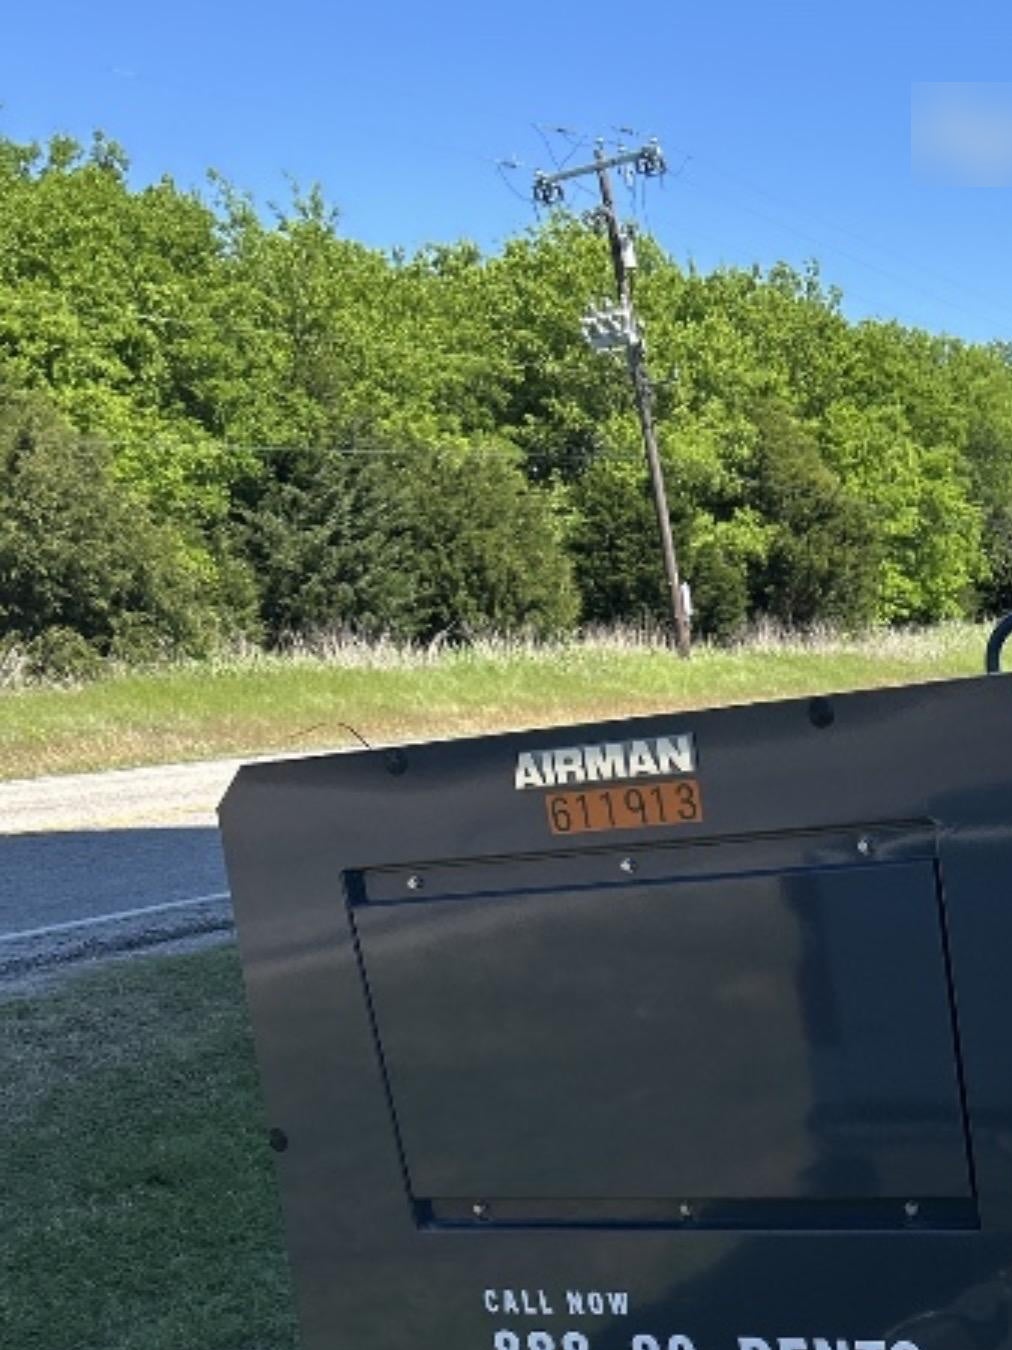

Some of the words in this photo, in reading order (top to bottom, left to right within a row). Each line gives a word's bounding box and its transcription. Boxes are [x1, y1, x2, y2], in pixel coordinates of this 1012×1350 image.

[515, 732, 696, 790] AIRMAN
[551, 782, 697, 832] 611913
[484, 1288, 555, 1316] CALL
[566, 1291, 629, 1316] NOW
